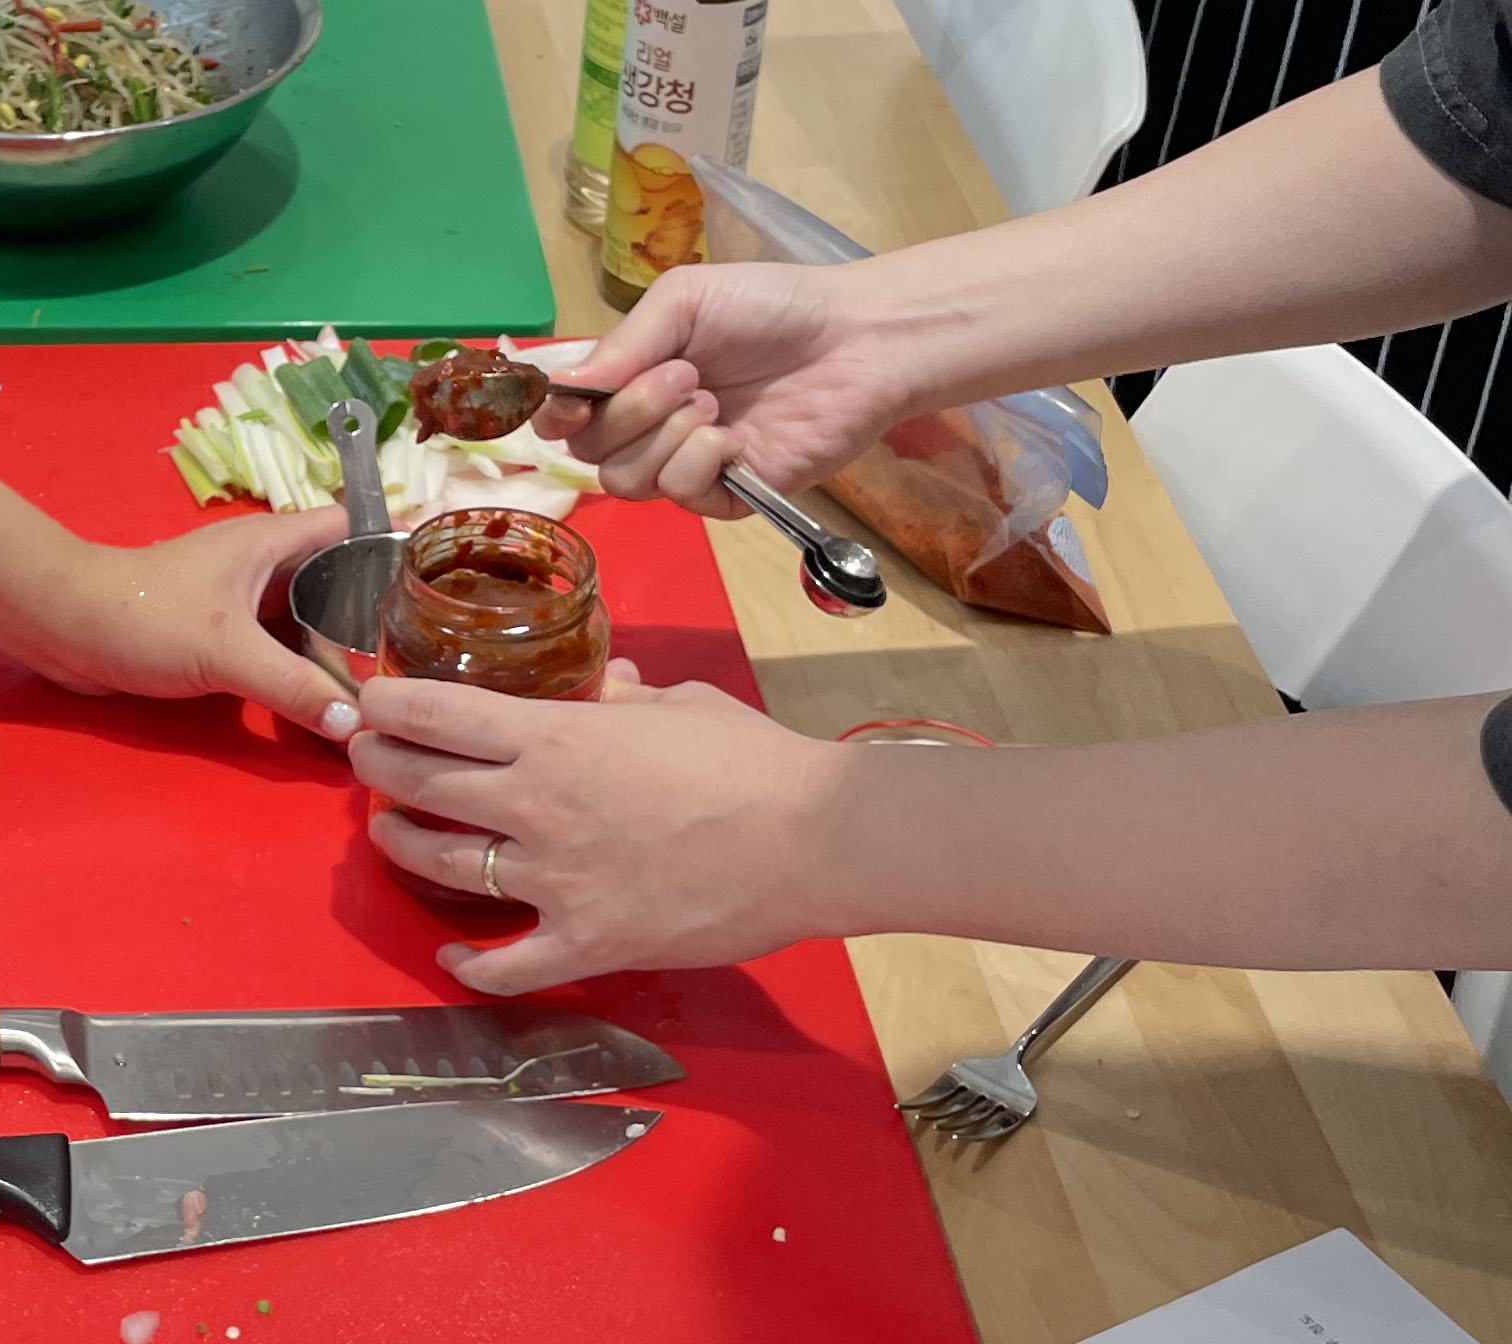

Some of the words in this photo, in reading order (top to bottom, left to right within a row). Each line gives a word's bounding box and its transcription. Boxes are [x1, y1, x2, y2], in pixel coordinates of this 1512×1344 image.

[653, 7, 687, 35] 백설
[636, 39, 672, 73] 리얼
[622, 60, 695, 115] 생강청
